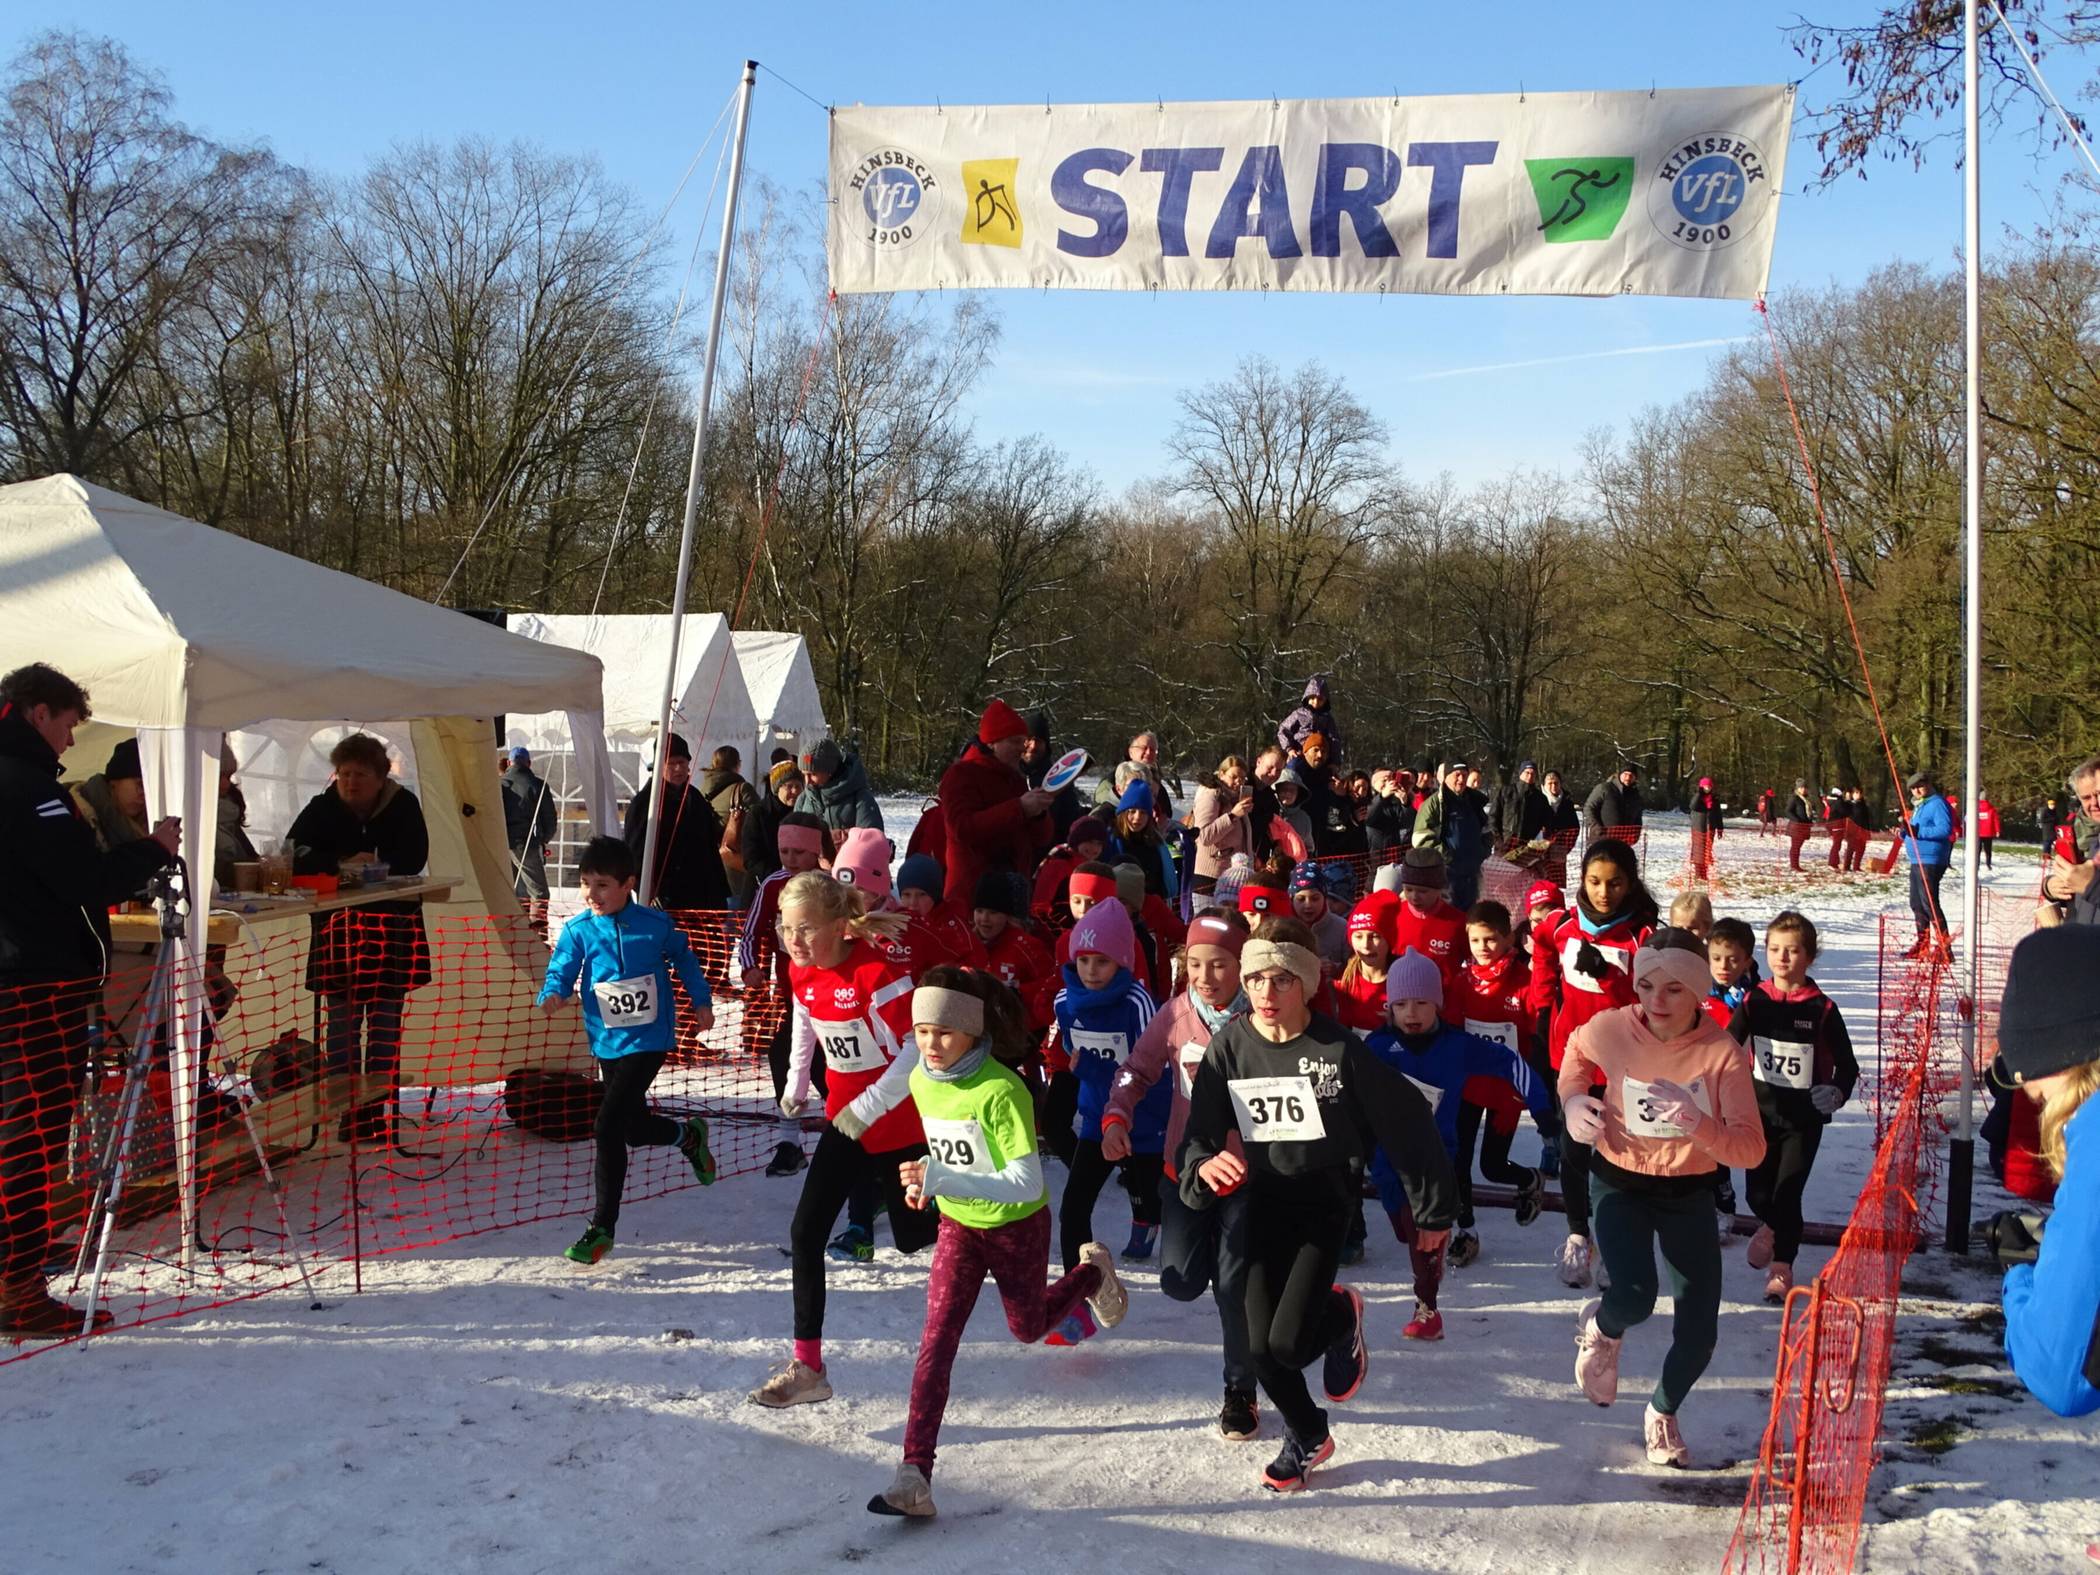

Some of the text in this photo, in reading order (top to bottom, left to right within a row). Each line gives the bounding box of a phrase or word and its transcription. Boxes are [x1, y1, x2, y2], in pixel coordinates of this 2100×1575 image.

[850, 150, 937, 192] HINSBECK
[1659, 137, 1765, 184] HINSBECK
[867, 182, 916, 220] VfL
[1050, 141, 1500, 259] START
[1680, 173, 1738, 214] VfL
[867, 224, 913, 245] 1900
[1672, 221, 1732, 244] 1900
[608, 990, 650, 1016] 392
[825, 1035, 861, 1059] 487
[1298, 1056, 1338, 1084] Enjoy
[1763, 1051, 1801, 1076] 375
[1249, 1096, 1305, 1125] 376
[930, 1138, 975, 1166] 529
